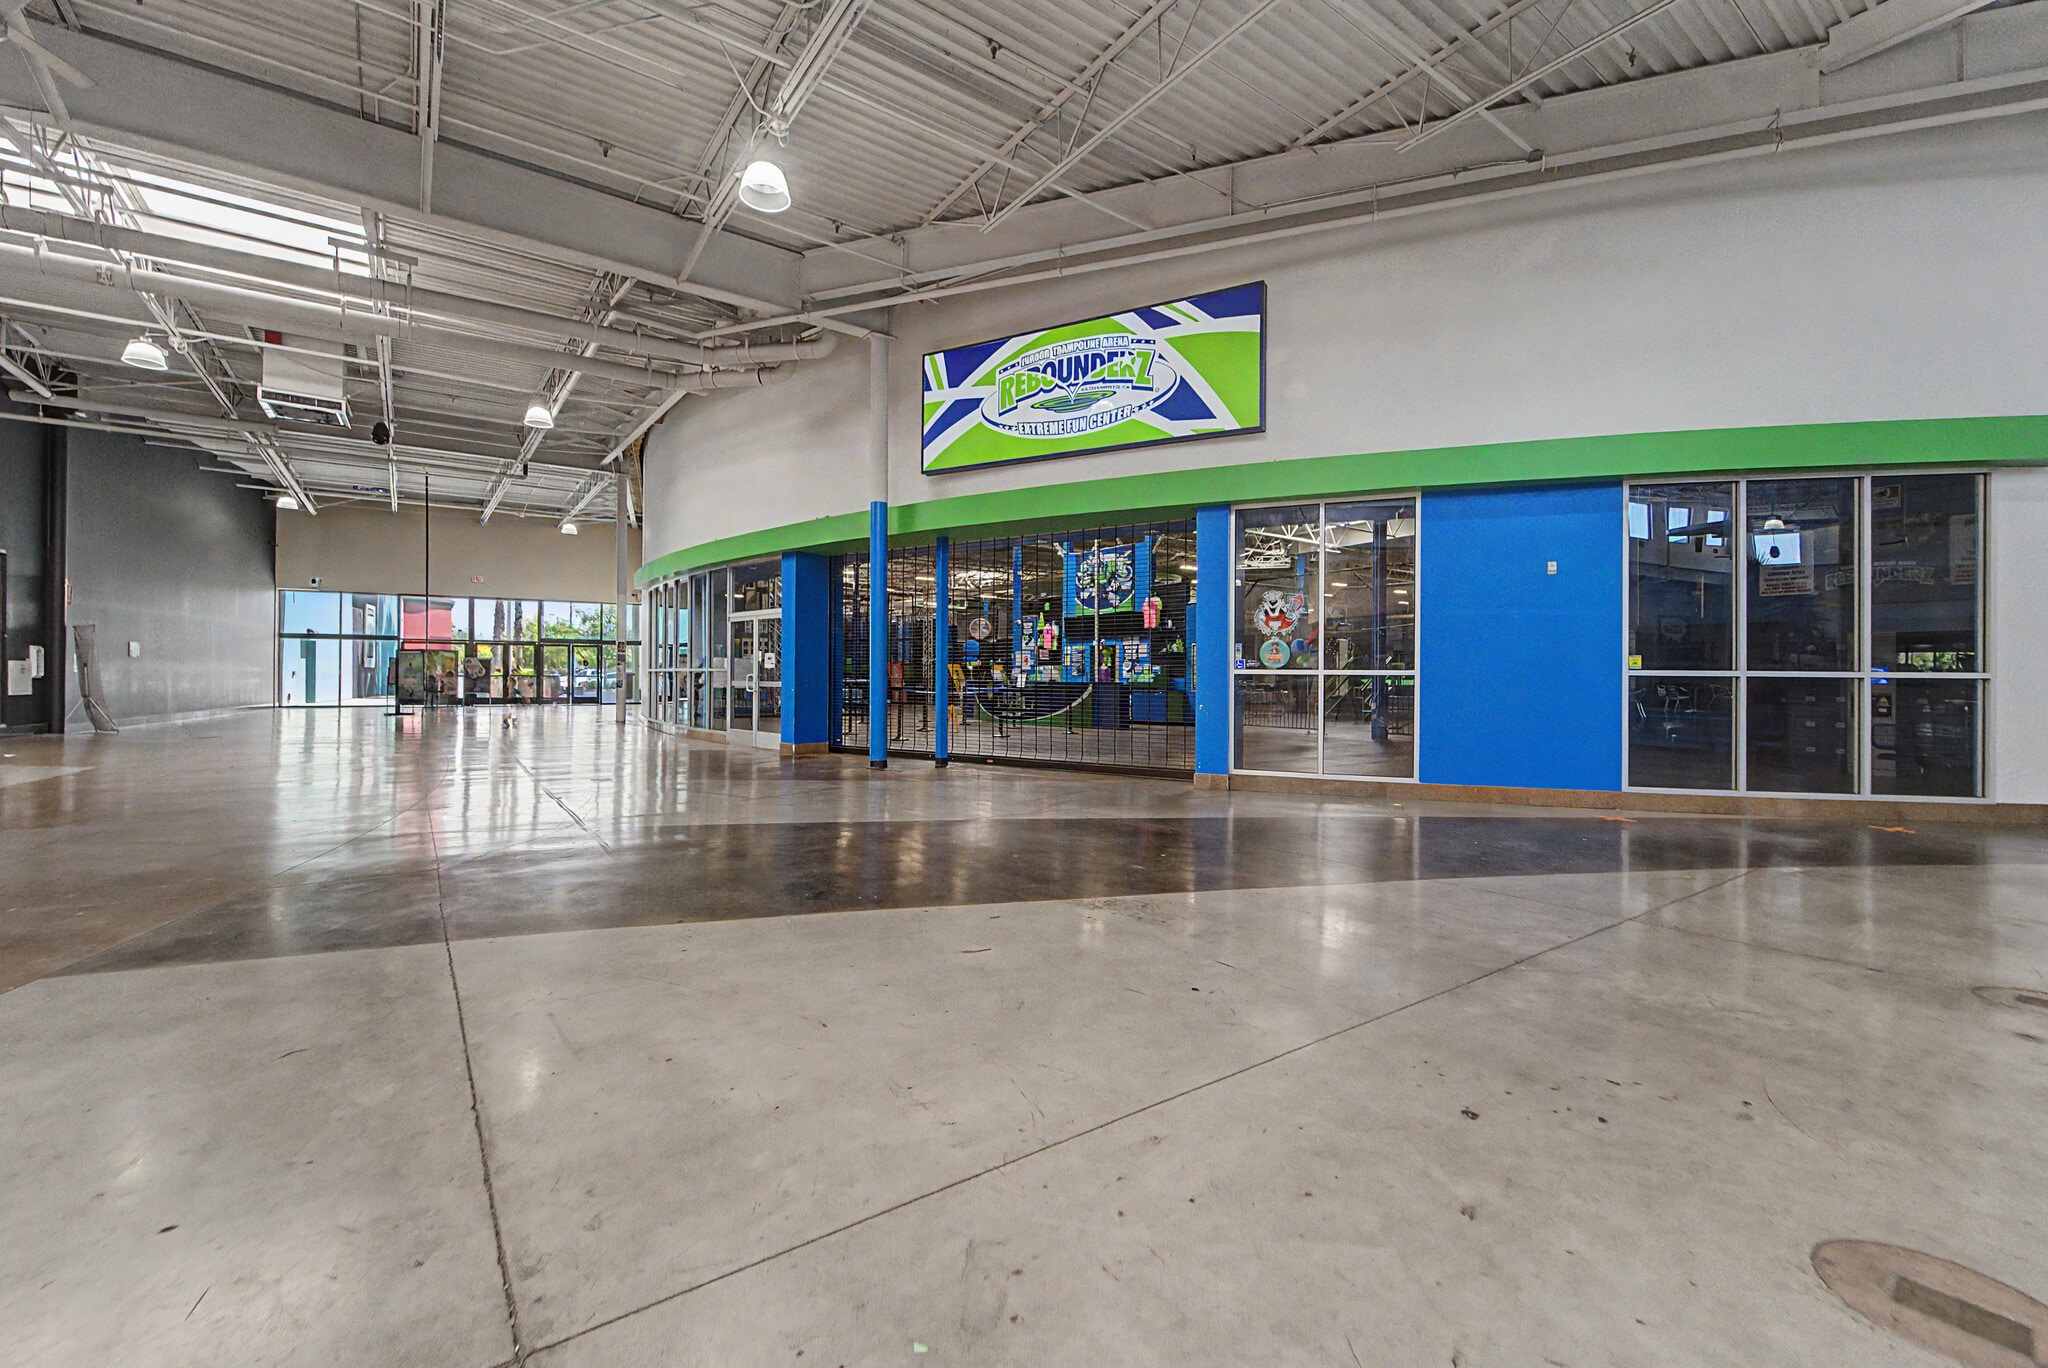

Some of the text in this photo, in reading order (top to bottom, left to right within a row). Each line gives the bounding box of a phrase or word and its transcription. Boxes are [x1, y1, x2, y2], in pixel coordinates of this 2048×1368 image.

[1052, 338, 1100, 356] TRAMPOLINE
[1101, 336, 1129, 348] ARENA
[999, 349, 1154, 414] REBOUNDERZ
[1017, 404, 1132, 435] EXTREME FUN CENTER
